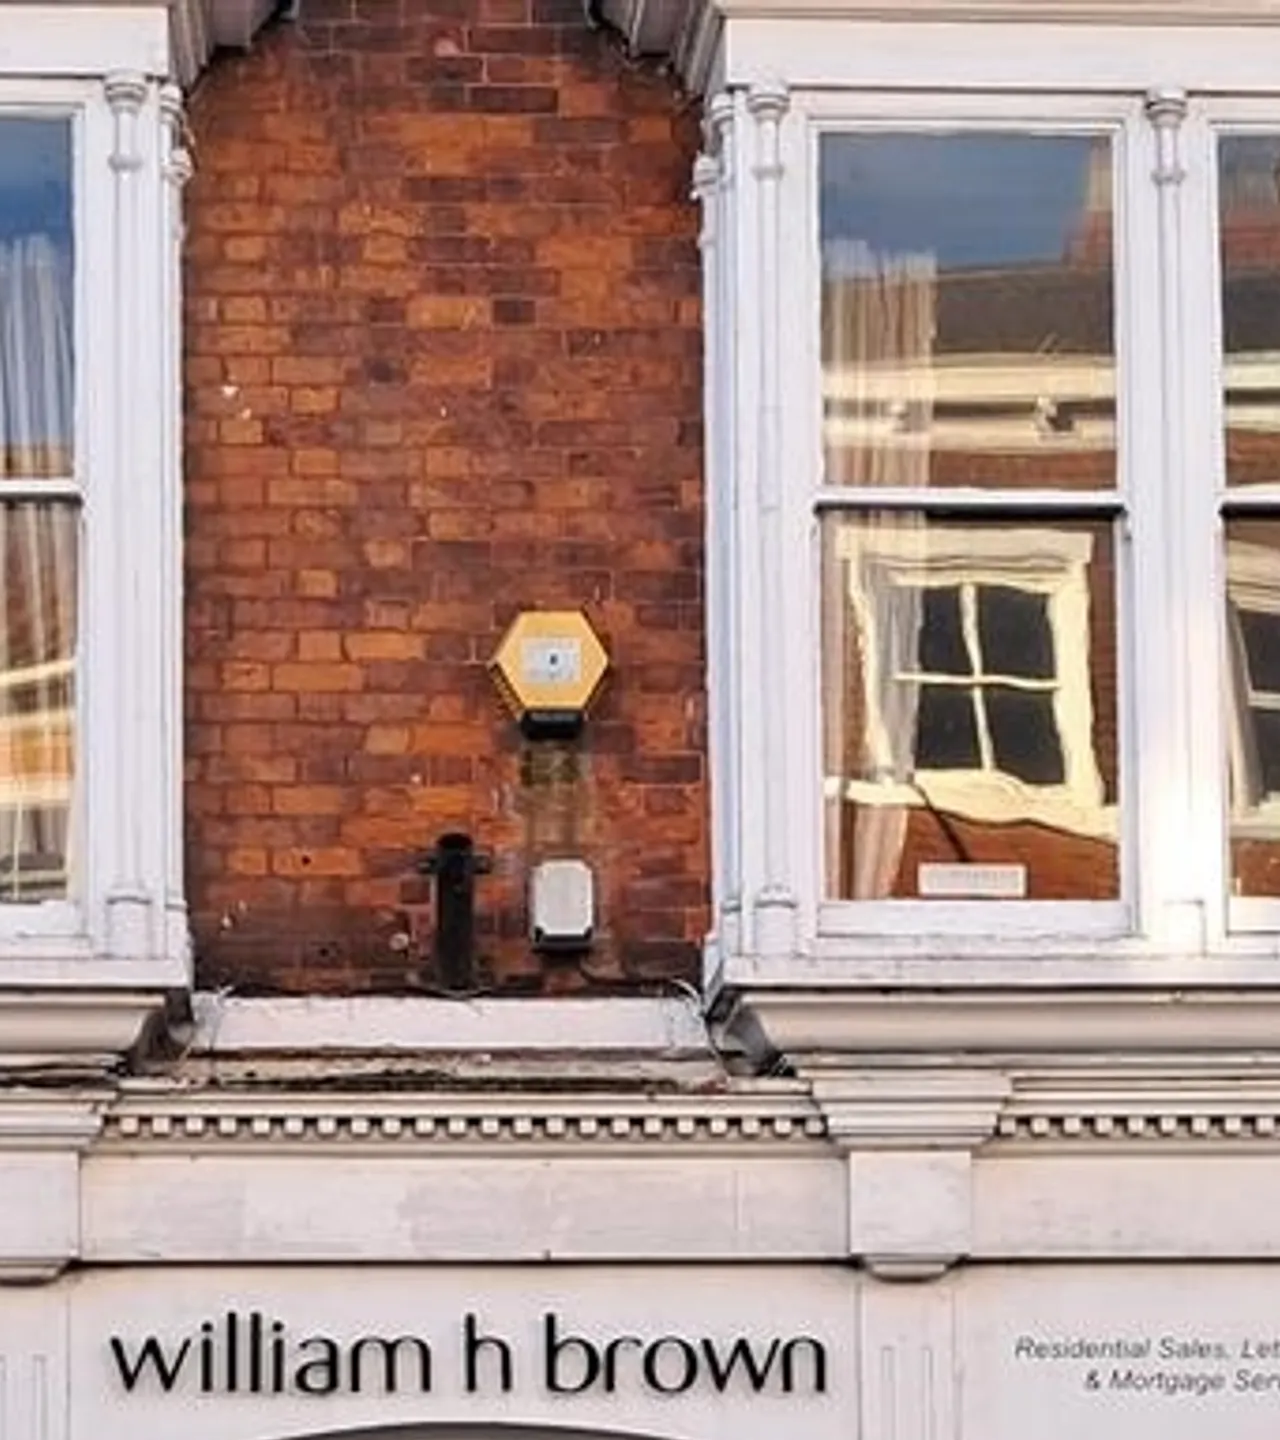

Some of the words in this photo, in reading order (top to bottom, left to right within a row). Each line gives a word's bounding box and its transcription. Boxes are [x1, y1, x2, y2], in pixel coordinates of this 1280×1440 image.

[111, 1312, 432, 1394] william
[464, 1312, 512, 1393] h
[545, 1312, 828, 1394] brown
[1014, 1336, 1151, 1360] Residential
[1084, 1370, 1100, 1391] &
[1109, 1370, 1226, 1396] Mortgage
